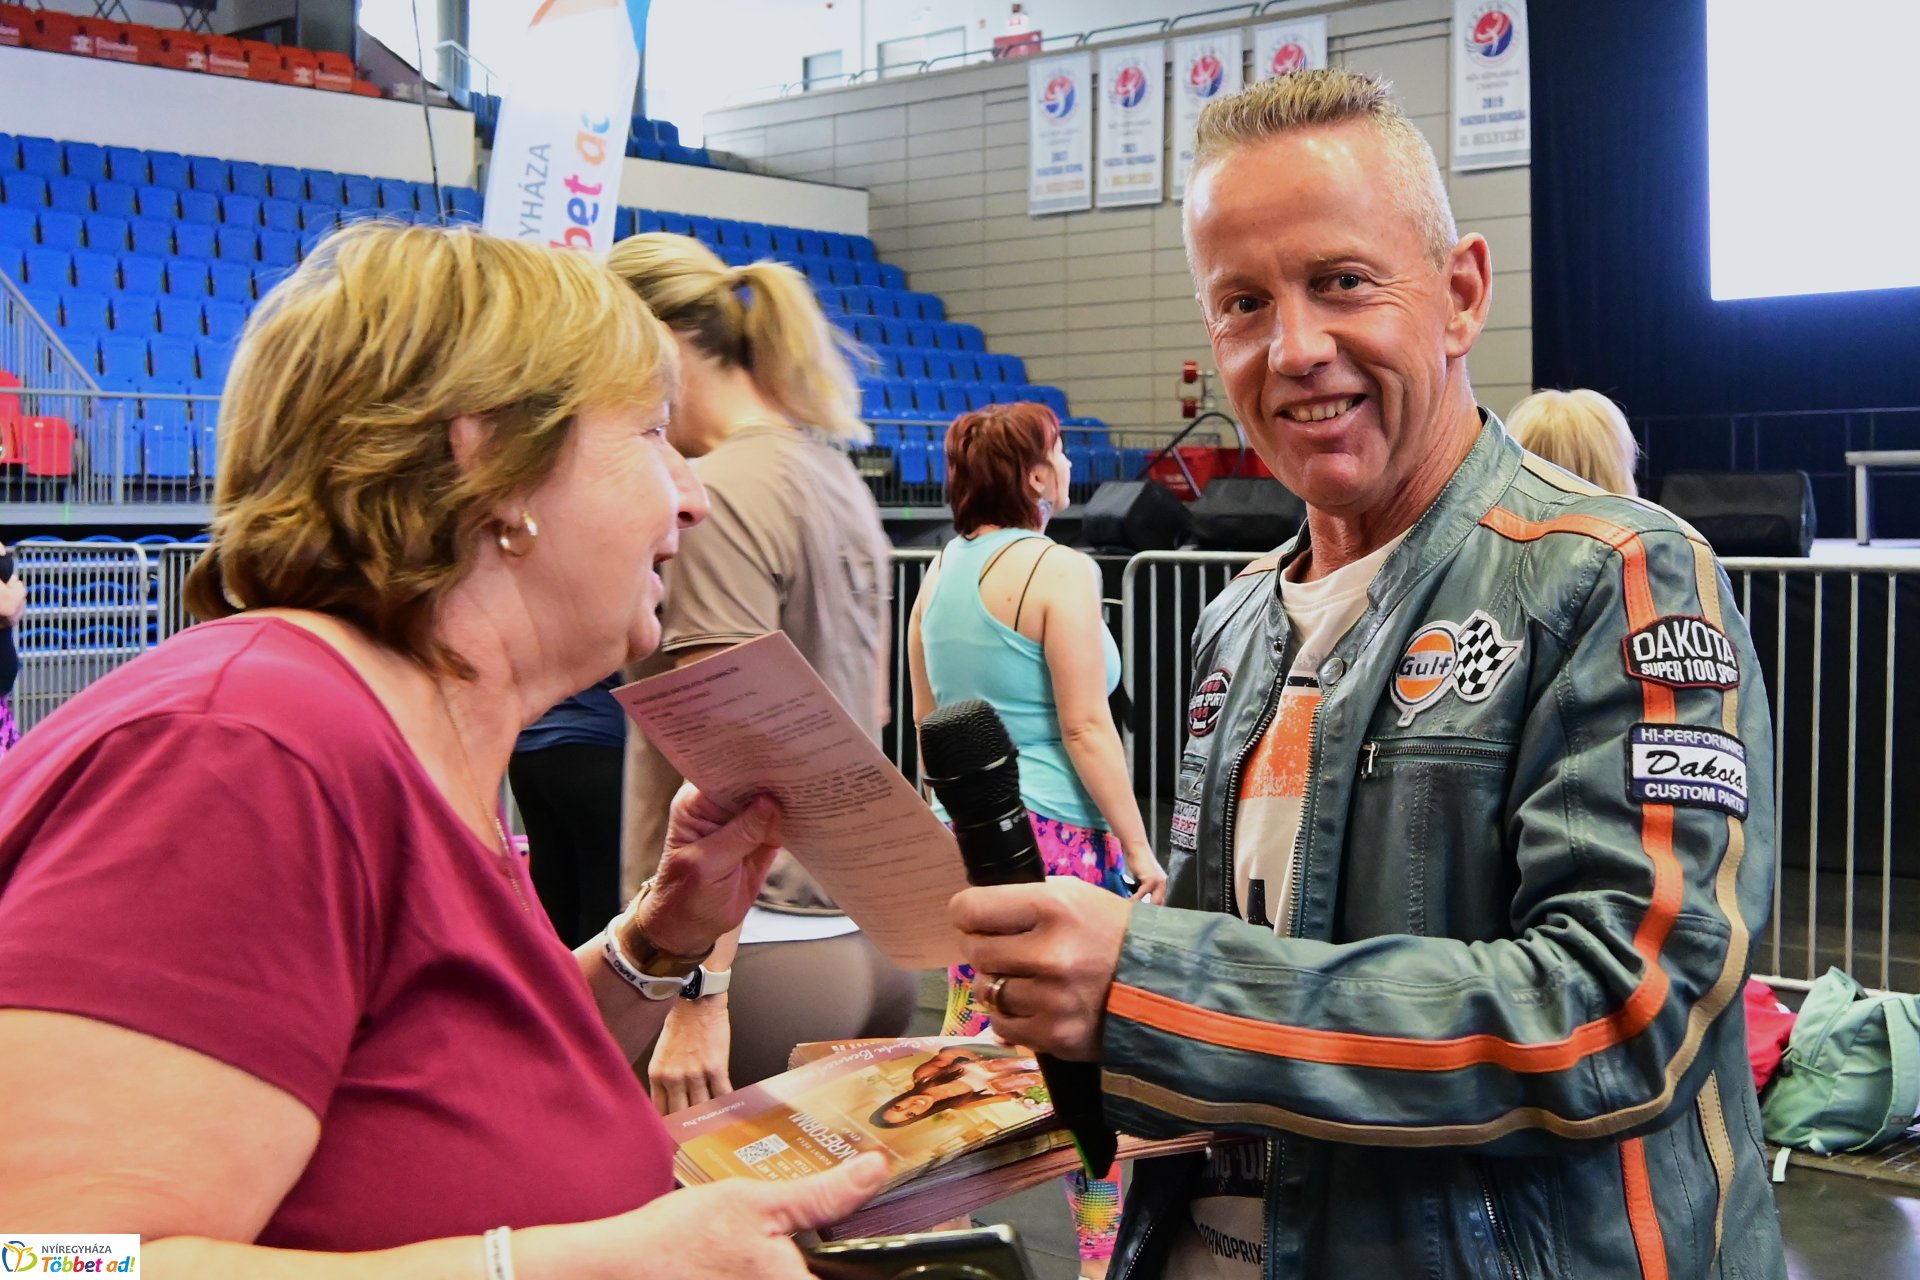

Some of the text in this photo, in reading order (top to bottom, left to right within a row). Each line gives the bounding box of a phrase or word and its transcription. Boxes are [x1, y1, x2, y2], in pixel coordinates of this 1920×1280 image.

[1633, 619, 1737, 668] DAKOTA
[1399, 655, 1453, 676] Gulf
[1640, 658, 1739, 684] SUPER 100 SPORT
[1641, 728, 1745, 760] HI-PERFORMANCE
[1645, 749, 1744, 789] Dakota
[1644, 783, 1745, 812] CUSTOM PARTS
